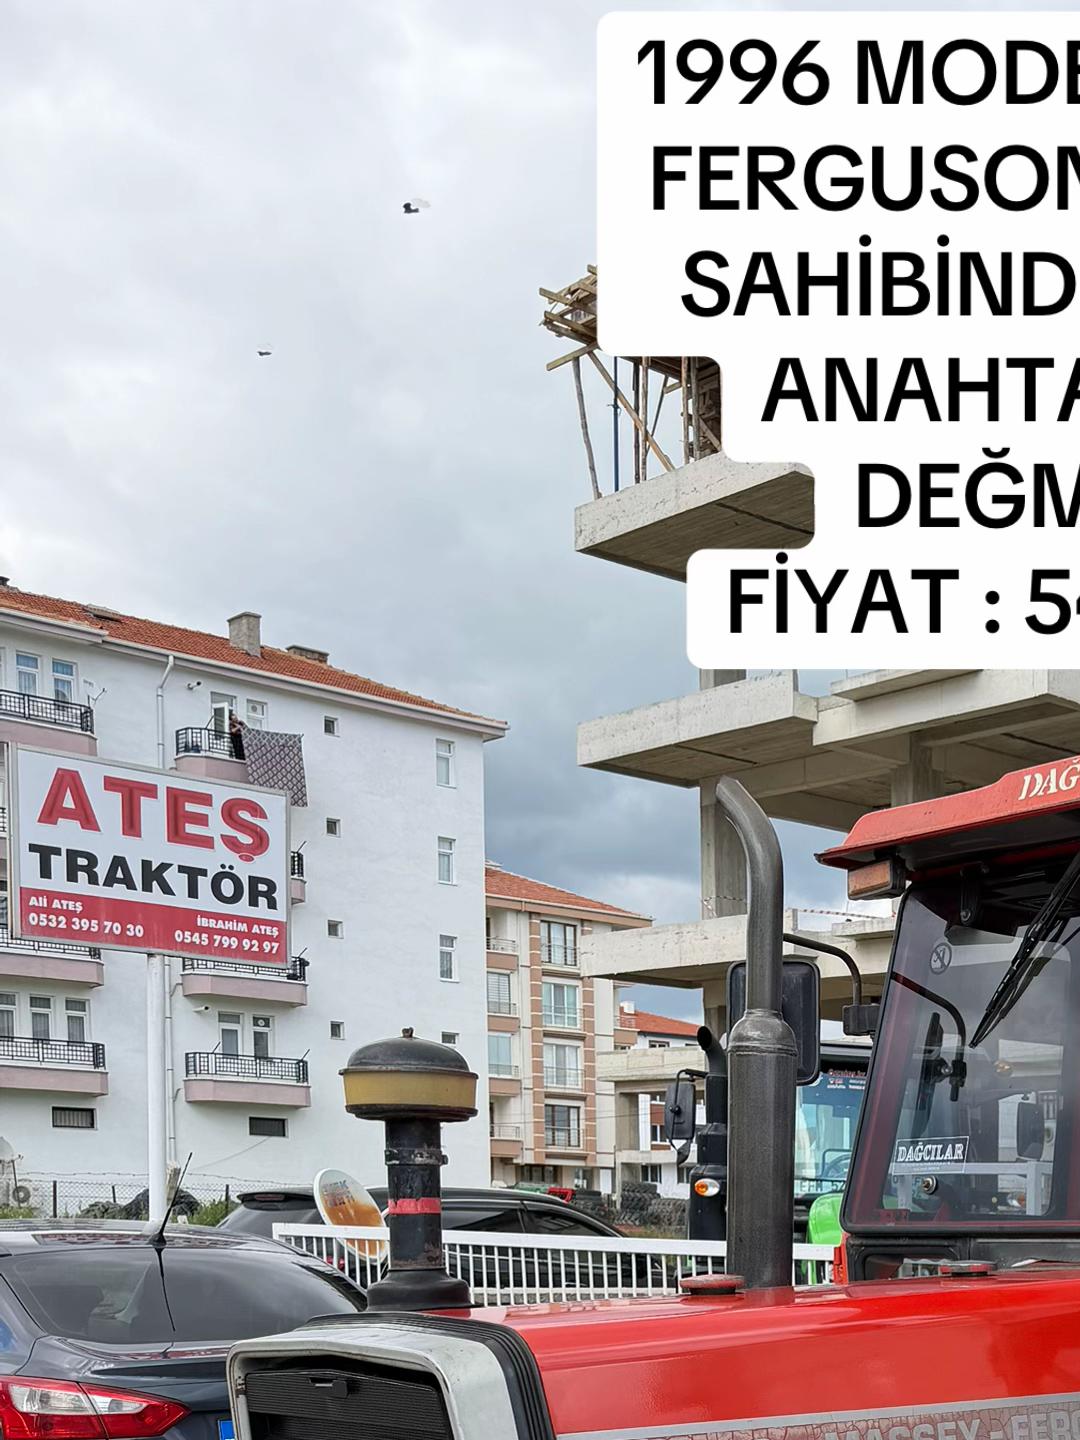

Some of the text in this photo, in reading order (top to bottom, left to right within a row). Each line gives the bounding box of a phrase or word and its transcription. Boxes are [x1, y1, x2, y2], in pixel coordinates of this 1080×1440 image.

[37, 767, 270, 863] ATEŞ
[29, 843, 278, 911] TRAKTÖR
[52, 899, 83, 913] ATEŞ
[29, 912, 144, 937] 0532 395 70 30
[174, 930, 279, 954] 0545 799 92 97
[897, 1142, 964, 1161] DAĞCILAR
